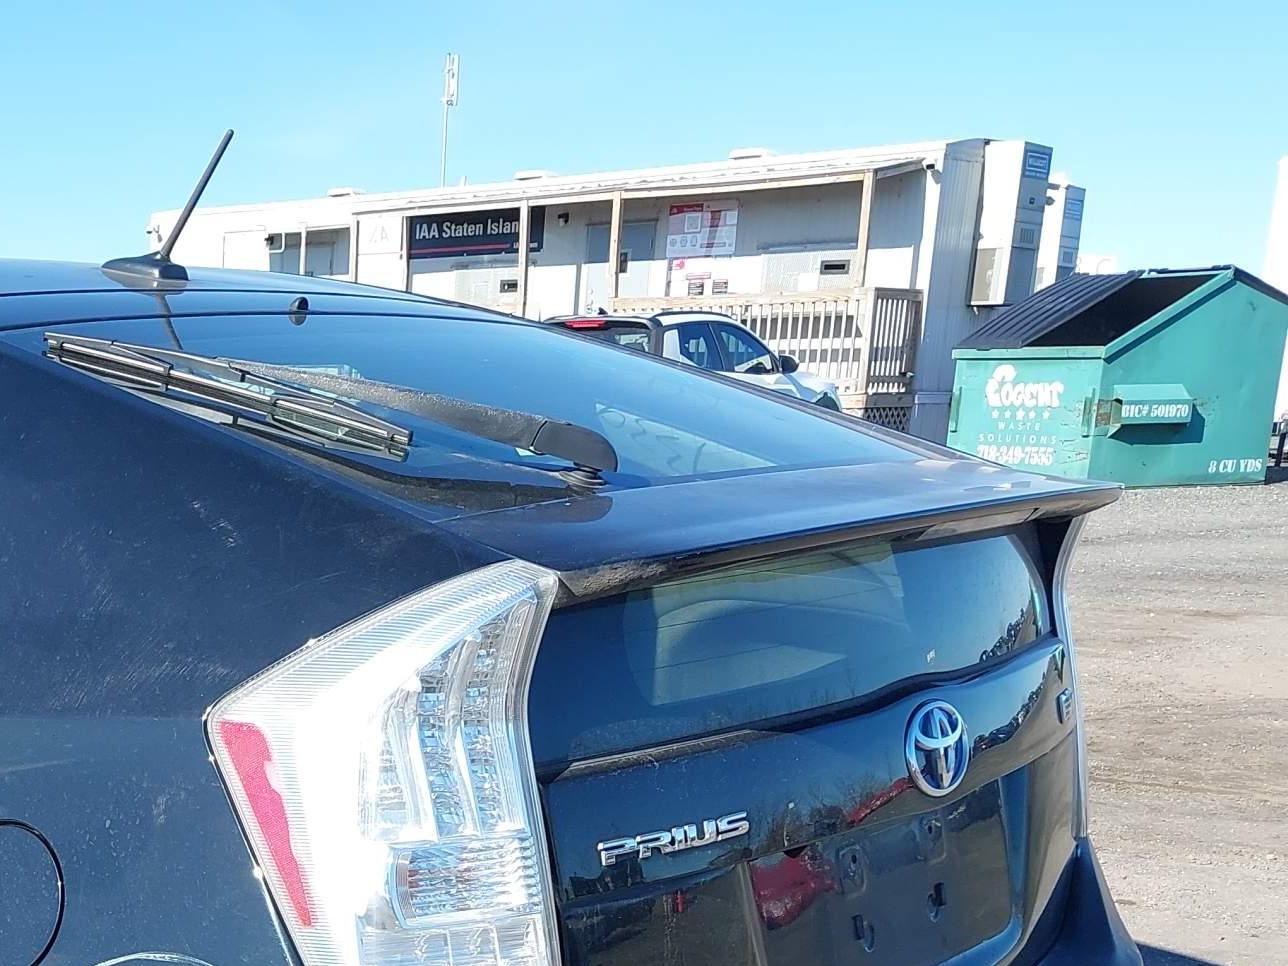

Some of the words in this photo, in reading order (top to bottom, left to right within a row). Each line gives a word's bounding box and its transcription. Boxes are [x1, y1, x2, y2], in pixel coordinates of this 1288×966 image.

[415, 222, 439, 240] IAA
[442, 220, 483, 238] Staten
[487, 217, 519, 235] Islan
[1121, 404, 1149, 418] BIC#
[1150, 404, 1188, 417] 501970
[997, 421, 1041, 430] WASTE
[977, 433, 1057, 444] SOLUTIONS
[1208, 461, 1217, 473] 8
[1219, 460, 1237, 473] CU
[1239, 459, 1263, 472] YDS
[597, 811, 750, 866] PRIUS
